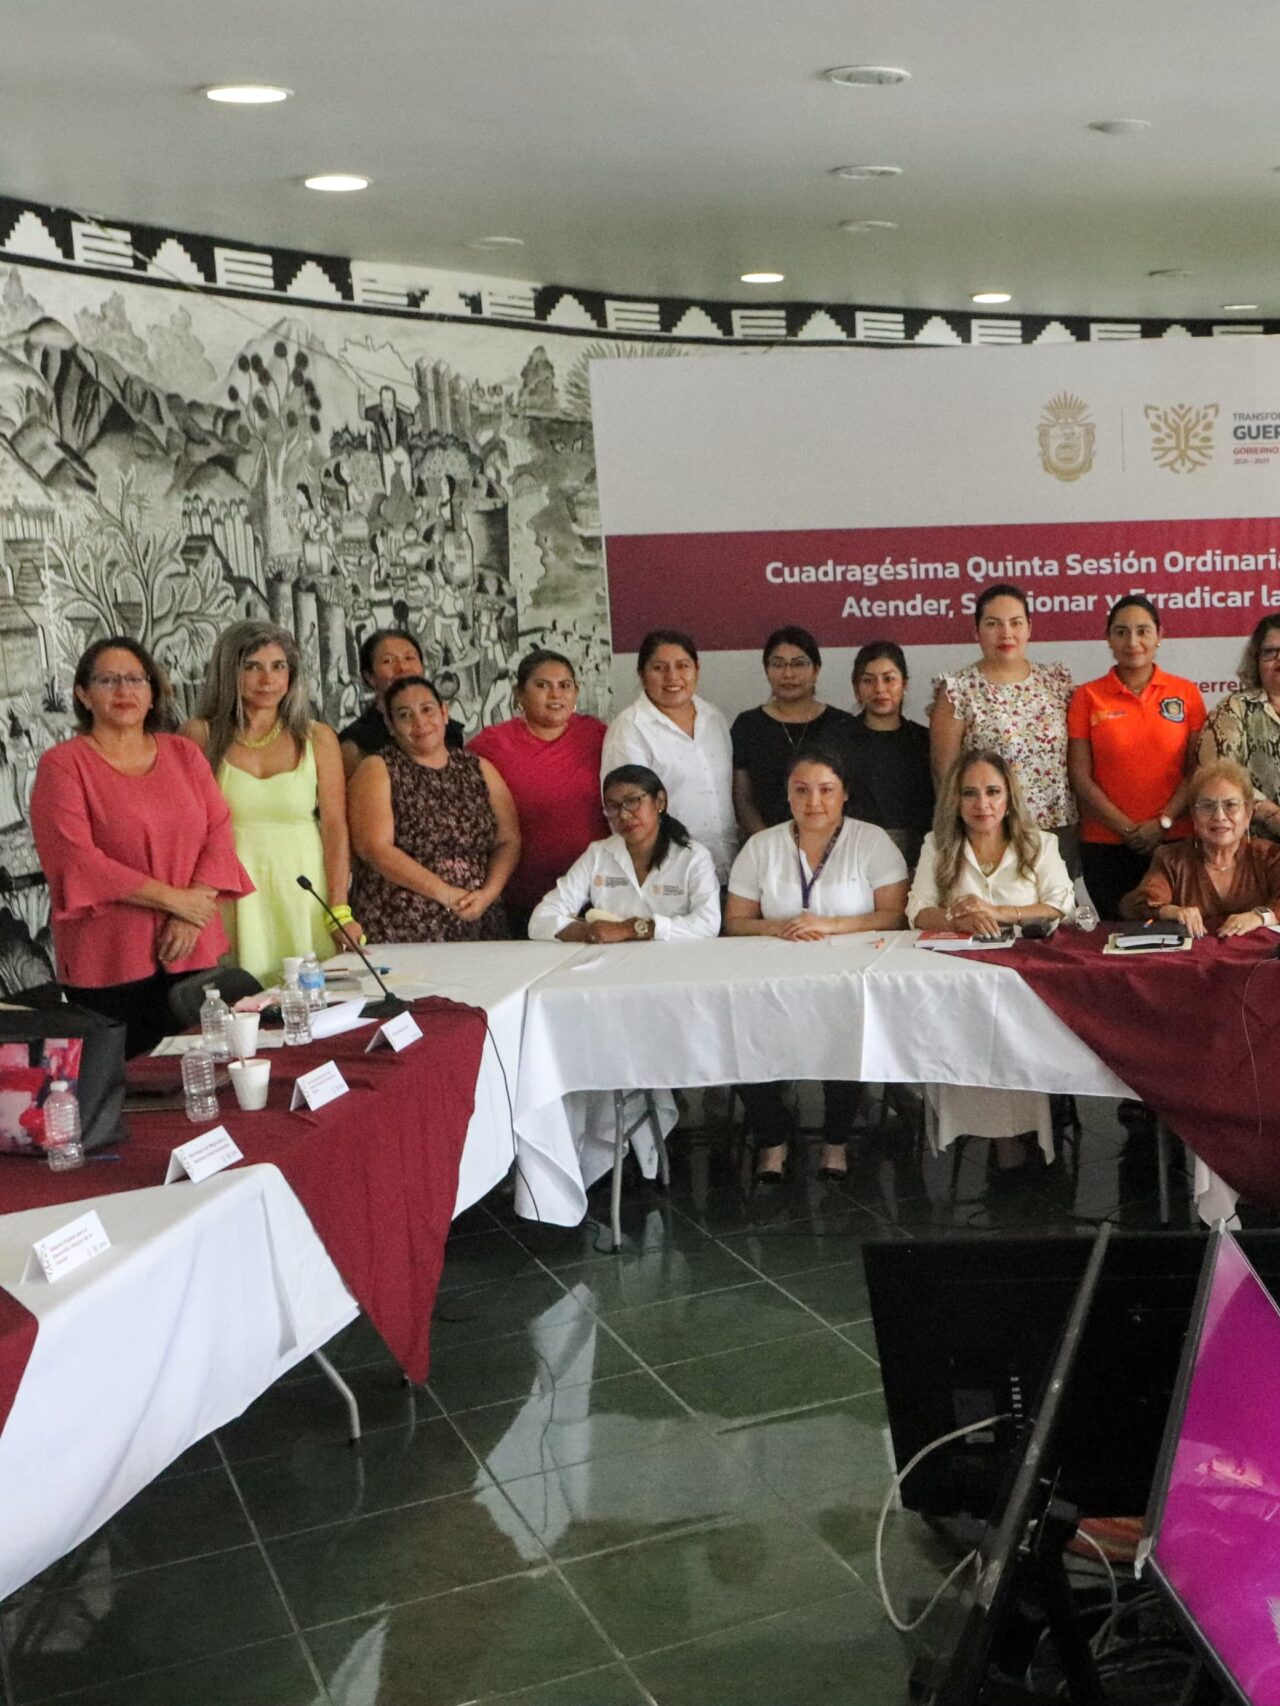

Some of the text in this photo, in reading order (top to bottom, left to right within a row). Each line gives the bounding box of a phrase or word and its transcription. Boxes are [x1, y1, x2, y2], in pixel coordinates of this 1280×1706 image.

[1233, 447, 1279, 455] GOBIERNO
[766, 556, 960, 585] Cuadragésima
[966, 555, 1058, 583] Quinta
[1066, 551, 1157, 577] Sesión
[842, 594, 954, 619] Atender,
[961, 590, 1097, 614] Sionar
